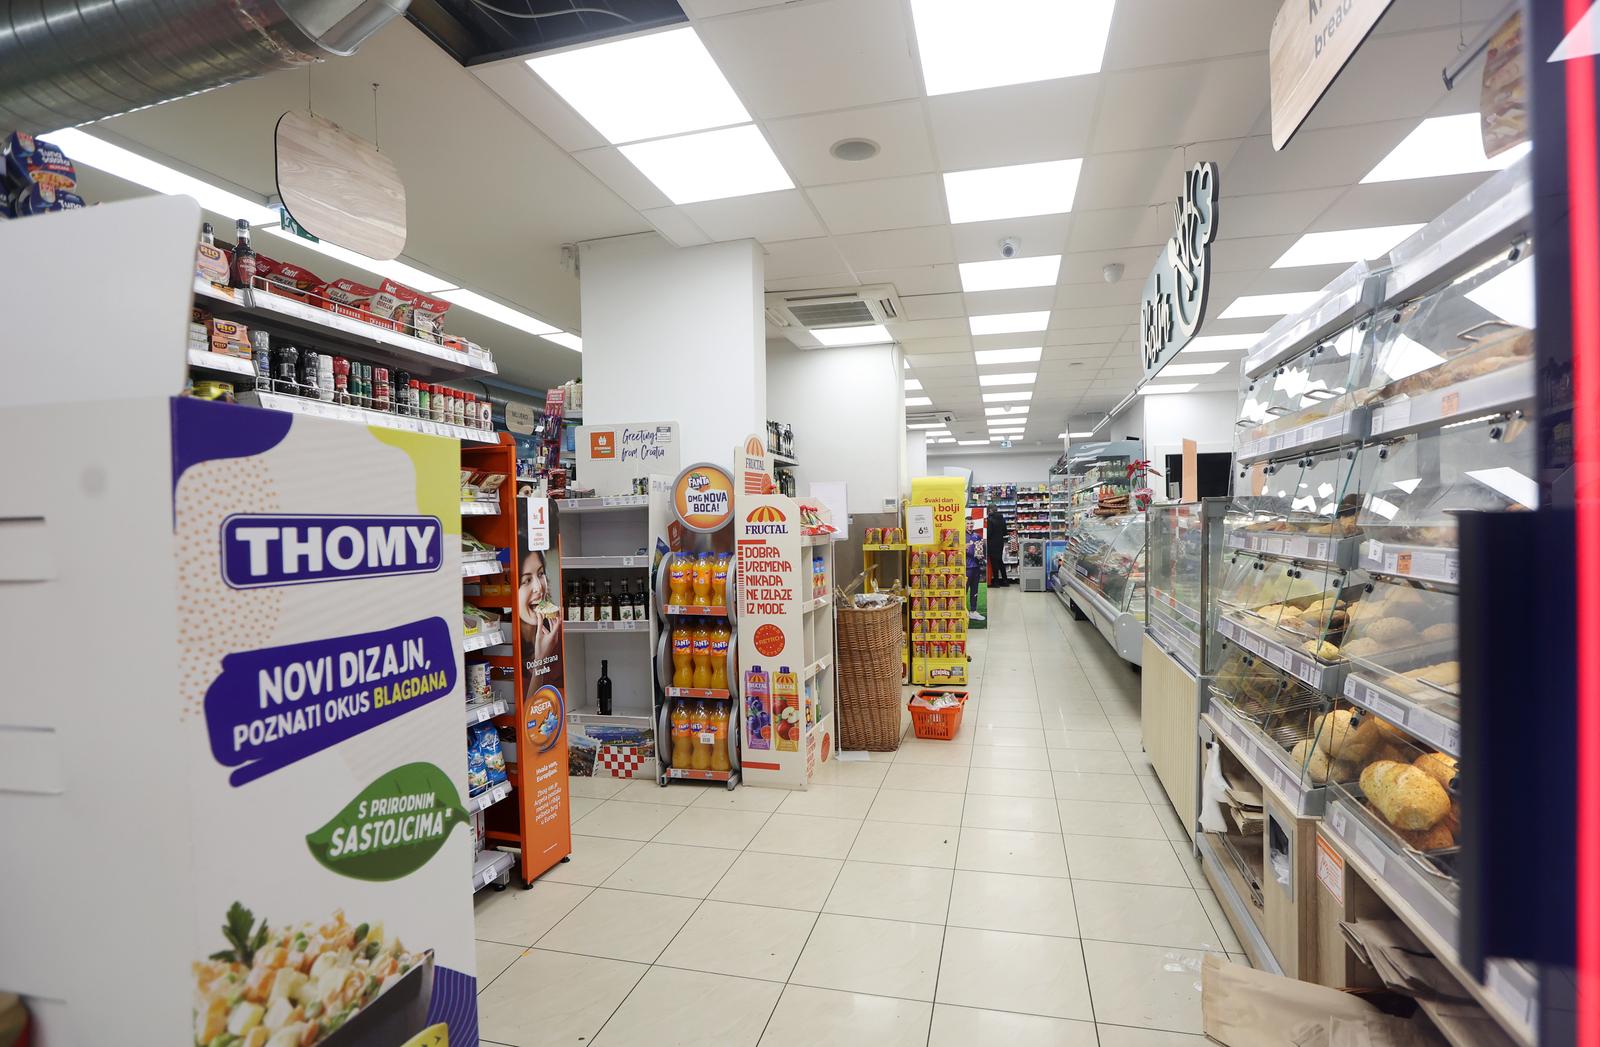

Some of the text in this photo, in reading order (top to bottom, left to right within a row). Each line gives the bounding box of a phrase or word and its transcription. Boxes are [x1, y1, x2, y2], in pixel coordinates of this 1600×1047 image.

[217, 324, 236, 332] RIO
[622, 444, 664, 462] from Croatia
[746, 458, 765, 470] FRUCTAL
[688, 476, 710, 488] FANTA
[688, 492, 727, 503] OMG NOVA
[694, 503, 720, 512] BOCA!
[938, 504, 960, 514] bolji
[538, 506, 544, 524] 1
[745, 524, 789, 535] FRUCTAL
[235, 525, 436, 576] THOMY
[745, 546, 780, 558] DOBRA
[746, 560, 792, 572] VREMENA
[746, 574, 784, 586] NIKADA
[746, 588, 792, 600] NE IZLAZE
[746, 602, 787, 614] IZ MODE.
[526, 654, 559, 670] Dobra strana
[258, 637, 432, 710] NOVI DIZAJN,
[535, 666, 550, 676] kruha
[233, 670, 448, 752] POZNATI OKUS BLAGDANA
[530, 701, 552, 716] ARGETA
[358, 792, 435, 819] S PRIRODNIM
